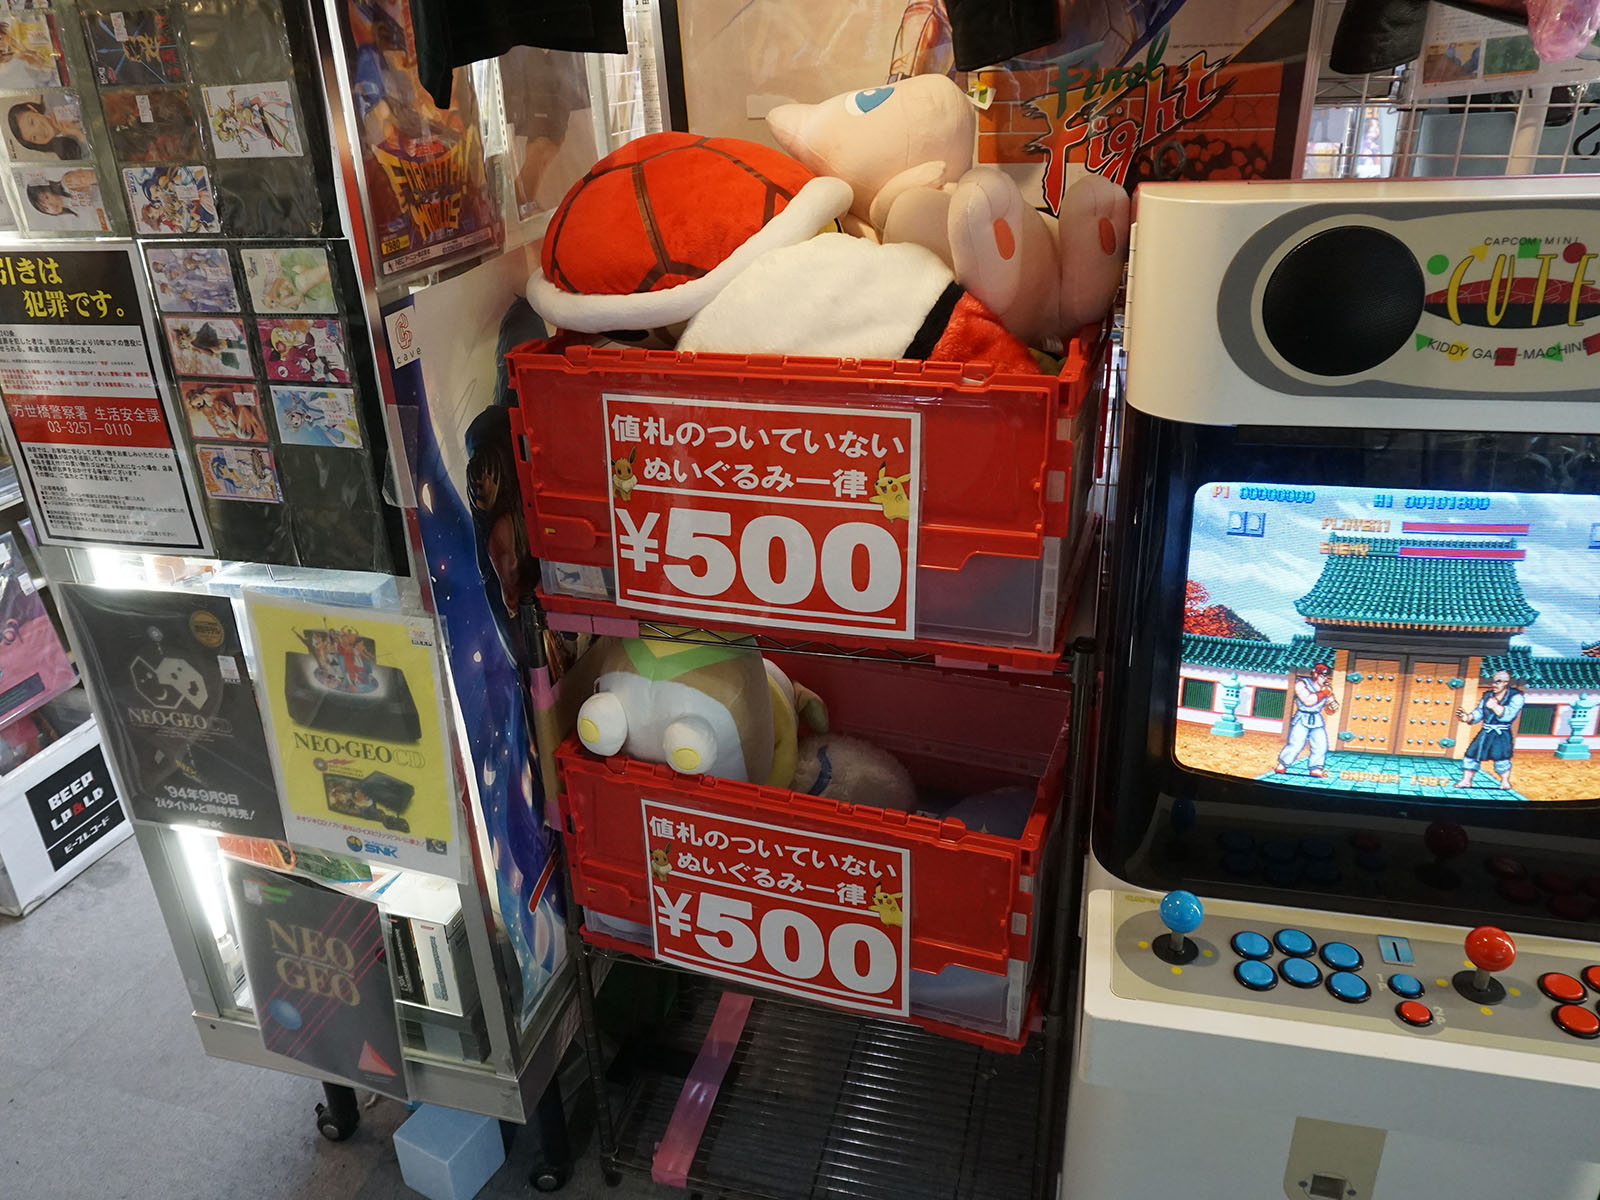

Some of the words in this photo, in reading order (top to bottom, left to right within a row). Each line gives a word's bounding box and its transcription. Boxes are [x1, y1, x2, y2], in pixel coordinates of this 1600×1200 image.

[1042, 23, 1172, 119] Final
[1022, 50, 1238, 218] Fight
[1483, 236, 1538, 247] CAPCOM
[23, 289, 125, 319] 犯罪です。
[1447, 253, 1599, 326] CUTE
[396, 346, 423, 365] cave
[1426, 339, 1469, 357] KIDDY
[11, 403, 89, 421] 万世橋警察署
[94, 406, 162, 424] 生活安全課
[611, 414, 905, 458] 値札のついていない
[643, 457, 868, 498] ぬいぐるみ一律
[1212, 485, 1230, 498] P1
[614, 507, 902, 613] ¥500
[47, 770, 94, 811] BEEP
[1410, 775, 1450, 787] 1987
[50, 786, 105, 831] LP&LD
[363, 843, 399, 859] SNK
[649, 815, 897, 879] 値札のついていない
[676, 852, 868, 906] ぬいぐるみ一律
[266, 918, 355, 969] NEO
[653, 885, 898, 994] ¥500
[276, 955, 361, 1007] GEO
